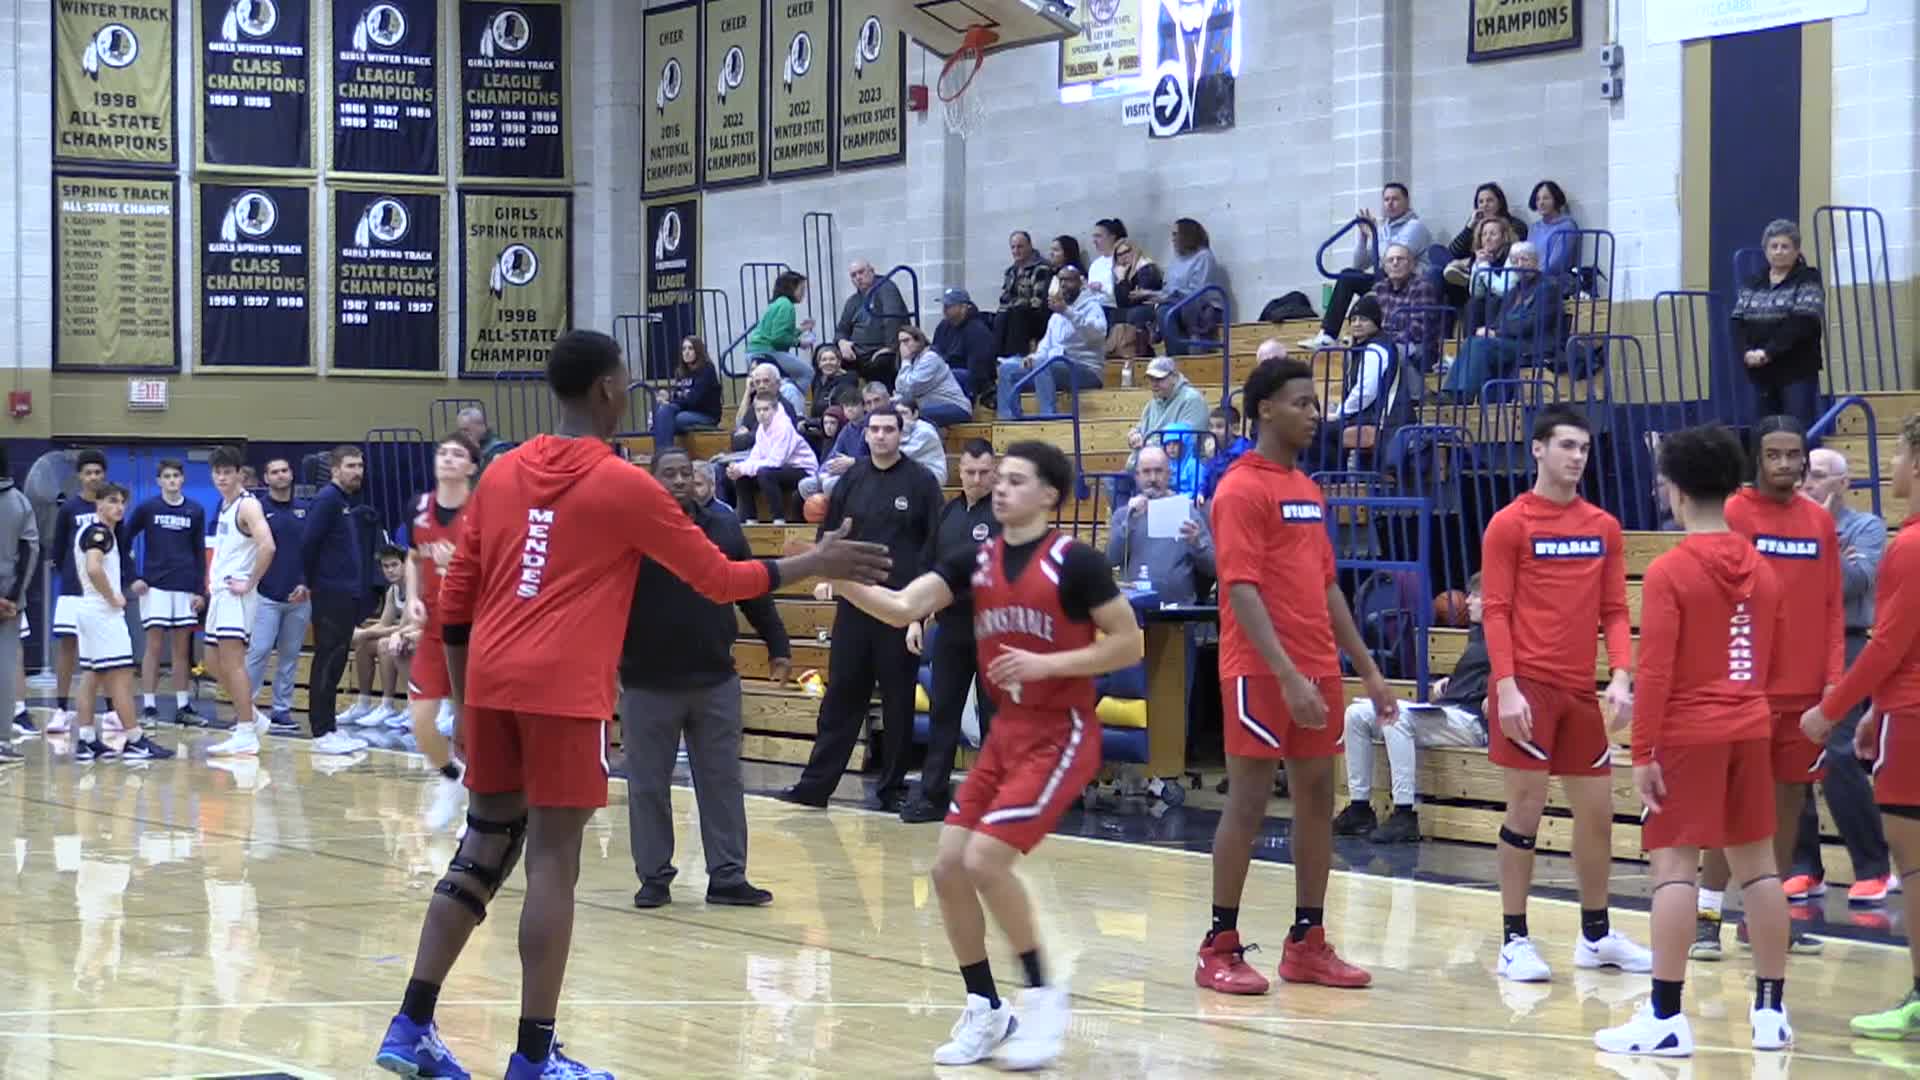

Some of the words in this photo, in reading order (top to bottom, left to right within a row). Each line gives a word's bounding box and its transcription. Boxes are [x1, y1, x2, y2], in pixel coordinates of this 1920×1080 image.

[61, 0, 116, 17] WINTER
[122, 5, 169, 21] TRACK
[787, 1, 813, 18] CHEER
[721, 16, 747, 33] CHEER
[1476, 6, 1568, 37] CHAMPIONS
[659, 30, 683, 46] CHEER
[273, 45, 303, 56] TRACK
[233, 59, 282, 75] CLASS
[367, 53, 401, 64] WINTER
[403, 55, 432, 66] TRACK
[468, 59, 492, 68] GIRLS
[495, 59, 526, 68] SPRING
[528, 61, 554, 70] TRACK
[208, 74, 305, 93] CHAMPIONS
[356, 67, 416, 85] LEAGUE
[484, 73, 542, 89] LEAGUE
[94, 92, 137, 108] 1998
[339, 83, 433, 102] CHAMPIONS
[467, 90, 559, 106] CHAMPIONS
[859, 87, 882, 104] 2023
[789, 101, 810, 118] 2022
[874, 107, 896, 122] STATE
[69, 111, 161, 130] ALL-STATE
[374, 119, 398, 130] 2021
[723, 112, 743, 128] 2022
[804, 119, 824, 135] STATE
[531, 125, 558, 134] 2000
[62, 131, 168, 151] CHAMPIONS
[469, 137, 496, 146] 2002
[710, 135, 729, 149] FALL
[731, 132, 754, 147] STATE
[843, 128, 896, 150] CHAMPIONS
[650, 142, 689, 161] NATIONAL
[774, 139, 824, 161] CHAMPIONS
[708, 151, 756, 171] CHAMPIONS
[647, 163, 693, 181] CHAMPIONS
[63, 185, 118, 198] SPRING
[123, 187, 169, 200] TRACK
[63, 201, 120, 214] ALL-STATE
[123, 203, 170, 215] CHAMPS
[495, 207, 538, 220] GIRLS
[471, 224, 518, 238] SPRING
[522, 226, 564, 239] TRACK
[273, 245, 302, 254] TRACK
[404, 251, 432, 260] TRACK
[231, 258, 280, 273] CLASS
[342, 264, 385, 278] STATE
[389, 266, 434, 280] RELAY
[207, 275, 305, 292] CHAMPIONS
[340, 279, 436, 296] CHAMPIONS
[497, 309, 537, 322] 1998
[478, 329, 557, 342] ALL-STATE
[516, 508, 554, 598] MENDES
[1729, 602, 1752, 680] ICHARDO
